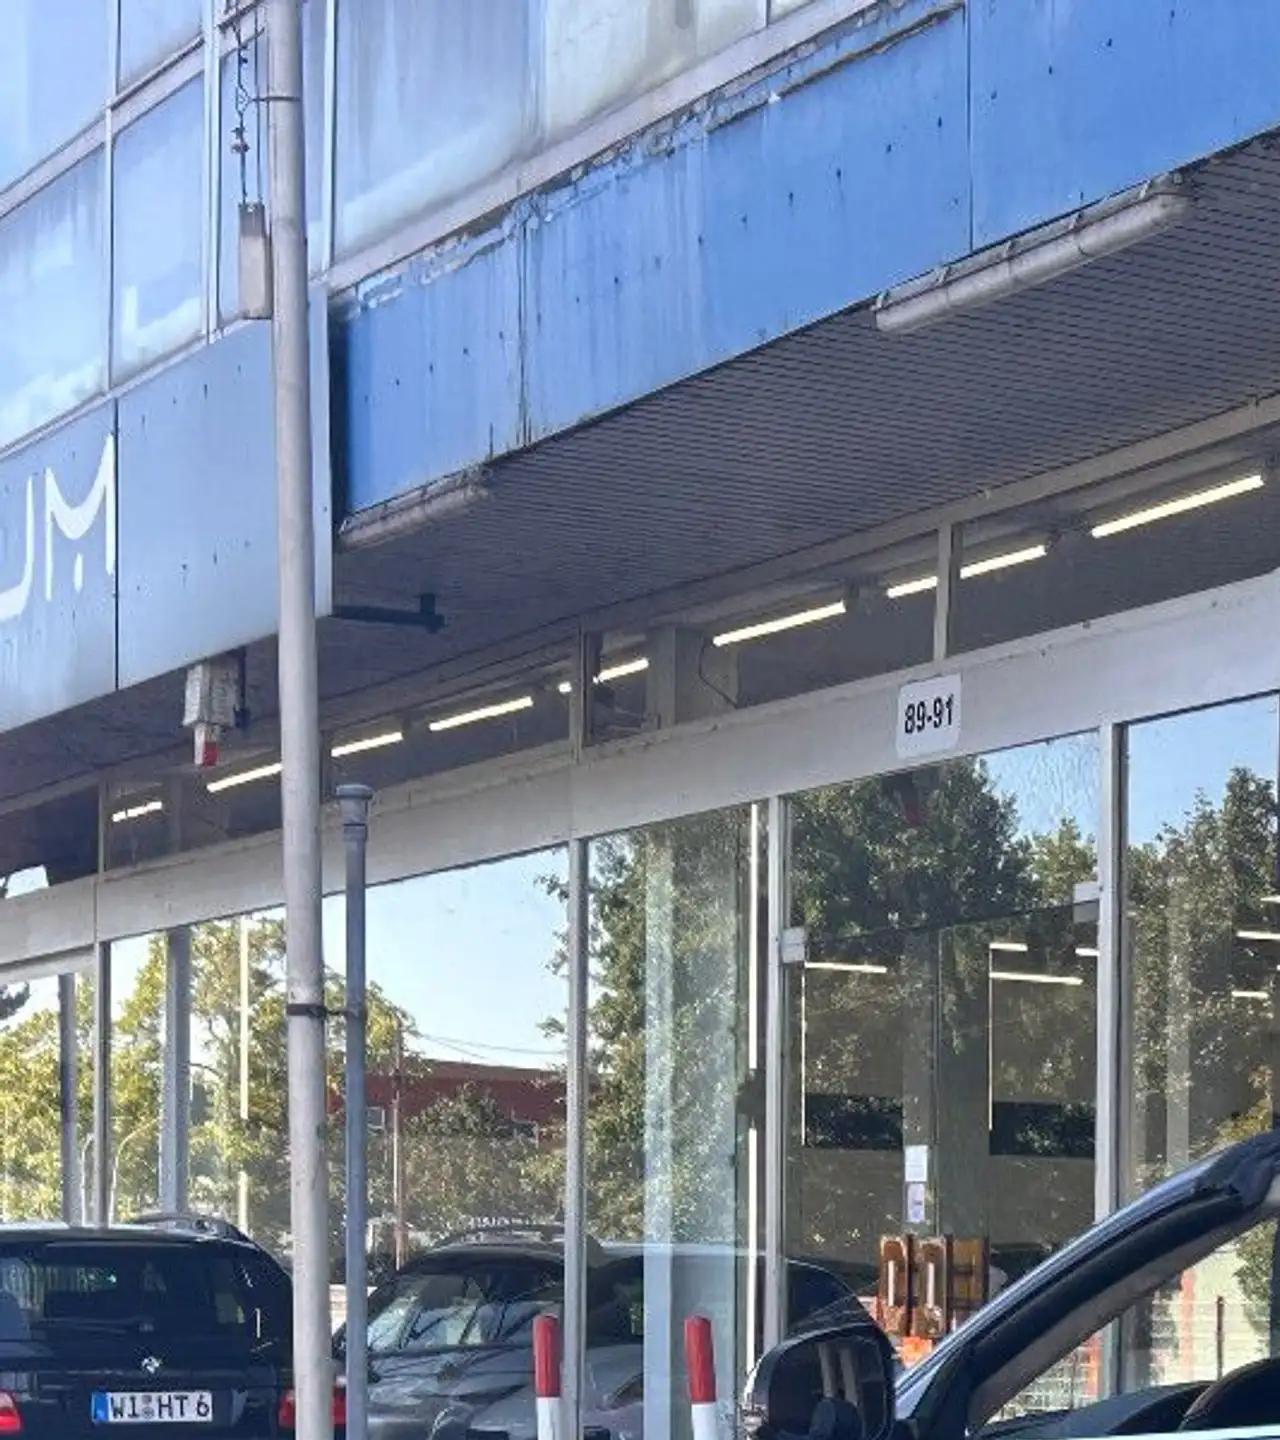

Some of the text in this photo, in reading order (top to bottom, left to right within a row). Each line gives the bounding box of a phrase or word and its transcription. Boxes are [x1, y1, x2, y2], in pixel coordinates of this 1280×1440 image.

[905, 693, 954, 734] 89-91
[110, 1395, 139, 1419] WI
[158, 1394, 189, 1419] HT
[197, 1394, 210, 1418] 6
